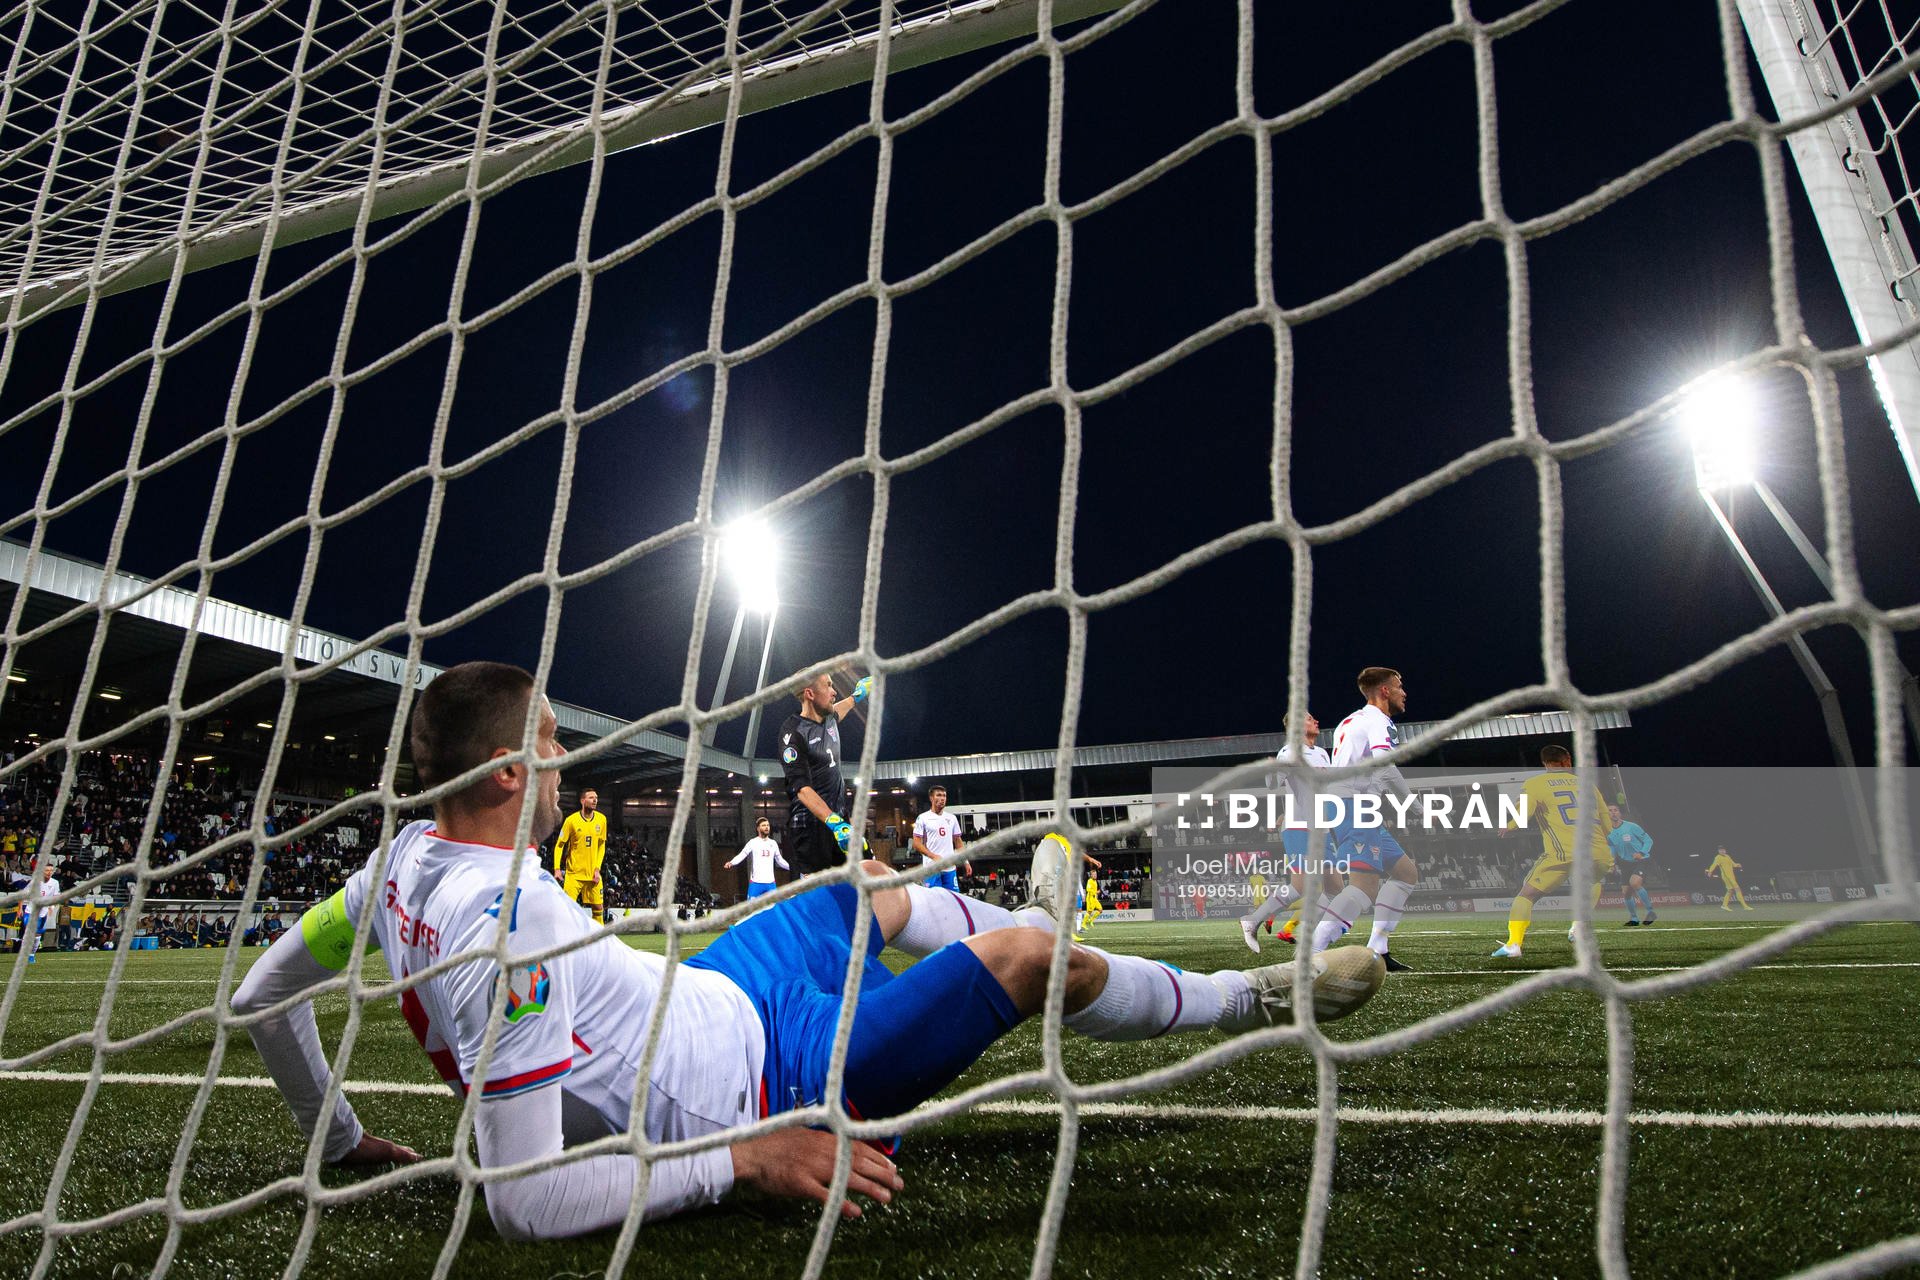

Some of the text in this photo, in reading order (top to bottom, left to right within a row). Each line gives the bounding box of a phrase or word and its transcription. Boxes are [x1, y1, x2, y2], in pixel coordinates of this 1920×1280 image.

[298, 633, 438, 685] TÓSVØ
[938, 827, 946, 837] 6
[585, 835, 592, 848] 9
[761, 849, 770, 857] 13
[1845, 887, 1867, 899] SOCAR
[1600, 895, 1641, 905] EUROPN
[1648, 894, 1688, 904] UALIFIERS
